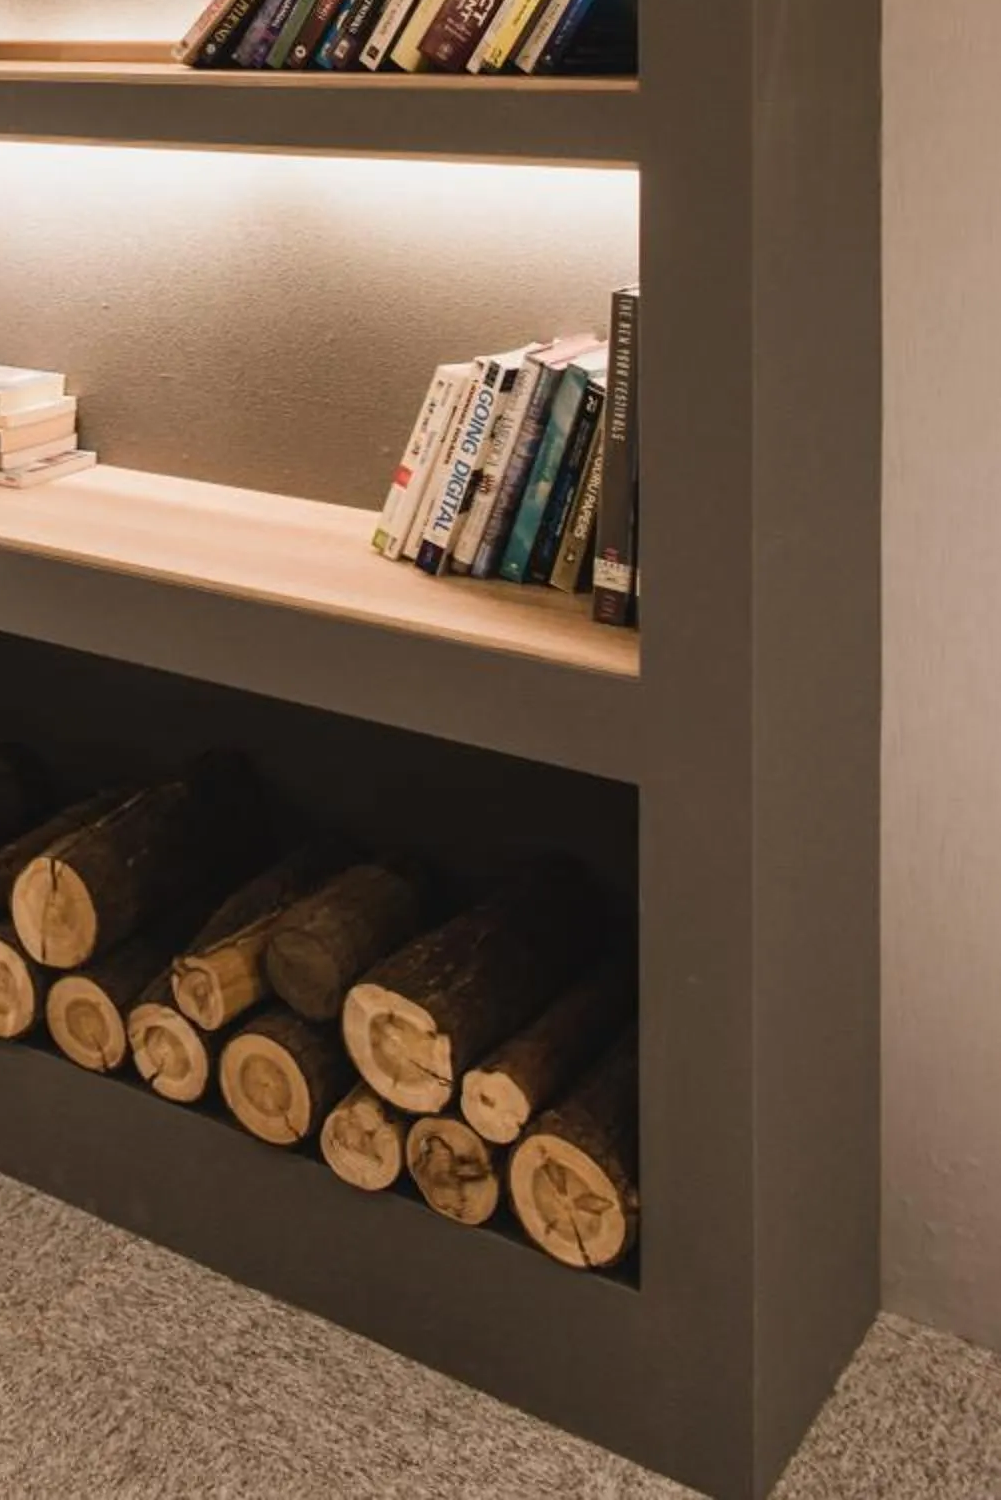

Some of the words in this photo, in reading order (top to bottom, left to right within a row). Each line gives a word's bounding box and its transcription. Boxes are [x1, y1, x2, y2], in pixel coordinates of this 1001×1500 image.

[461, 390, 494, 455] GOING
[432, 460, 470, 533] DIGITAL
[574, 493, 595, 538] PAPERS
